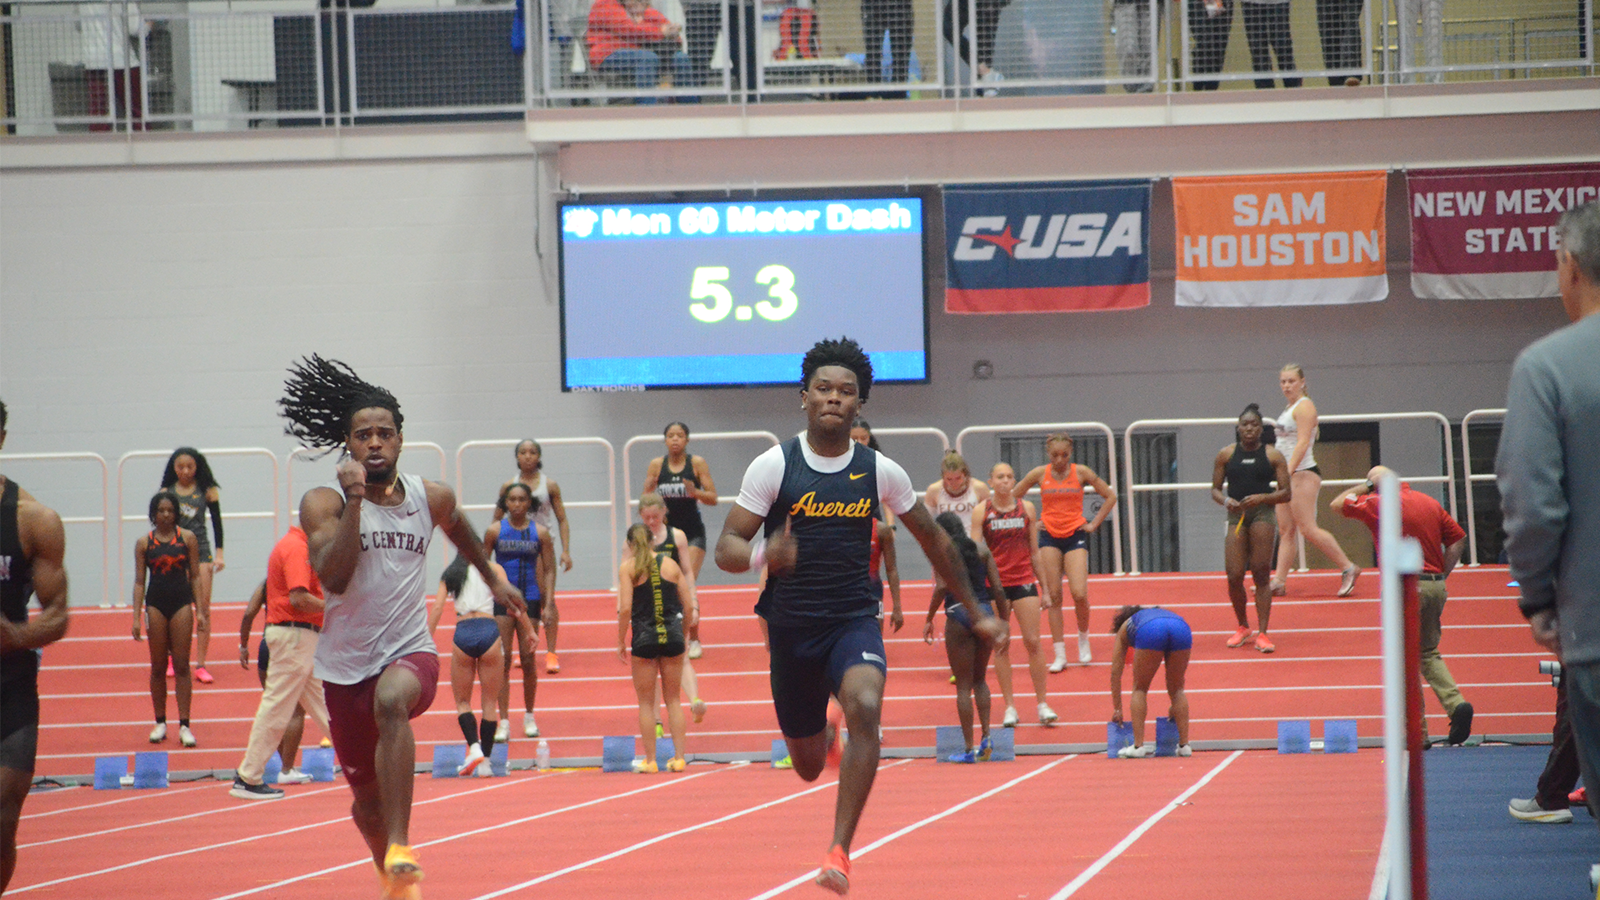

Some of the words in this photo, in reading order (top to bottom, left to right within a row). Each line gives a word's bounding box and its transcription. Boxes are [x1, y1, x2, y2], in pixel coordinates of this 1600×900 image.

[1233, 191, 1326, 227] SAM
[1413, 191, 1486, 218] NEW
[1496, 186, 1600, 216] MEXIC
[602, 207, 671, 235] Men
[678, 206, 719, 234] 60
[727, 204, 821, 233] Meter
[826, 202, 912, 230] Dash
[1183, 229, 1380, 268] HOUSTON
[1465, 226, 1561, 254] STATE
[689, 264, 799, 323] 5.3
[571, 384, 646, 393] DAKTRONICS
[789, 491, 871, 517] Averett
[939, 502, 976, 514] ELON
[372, 530, 426, 556] CENTRA
